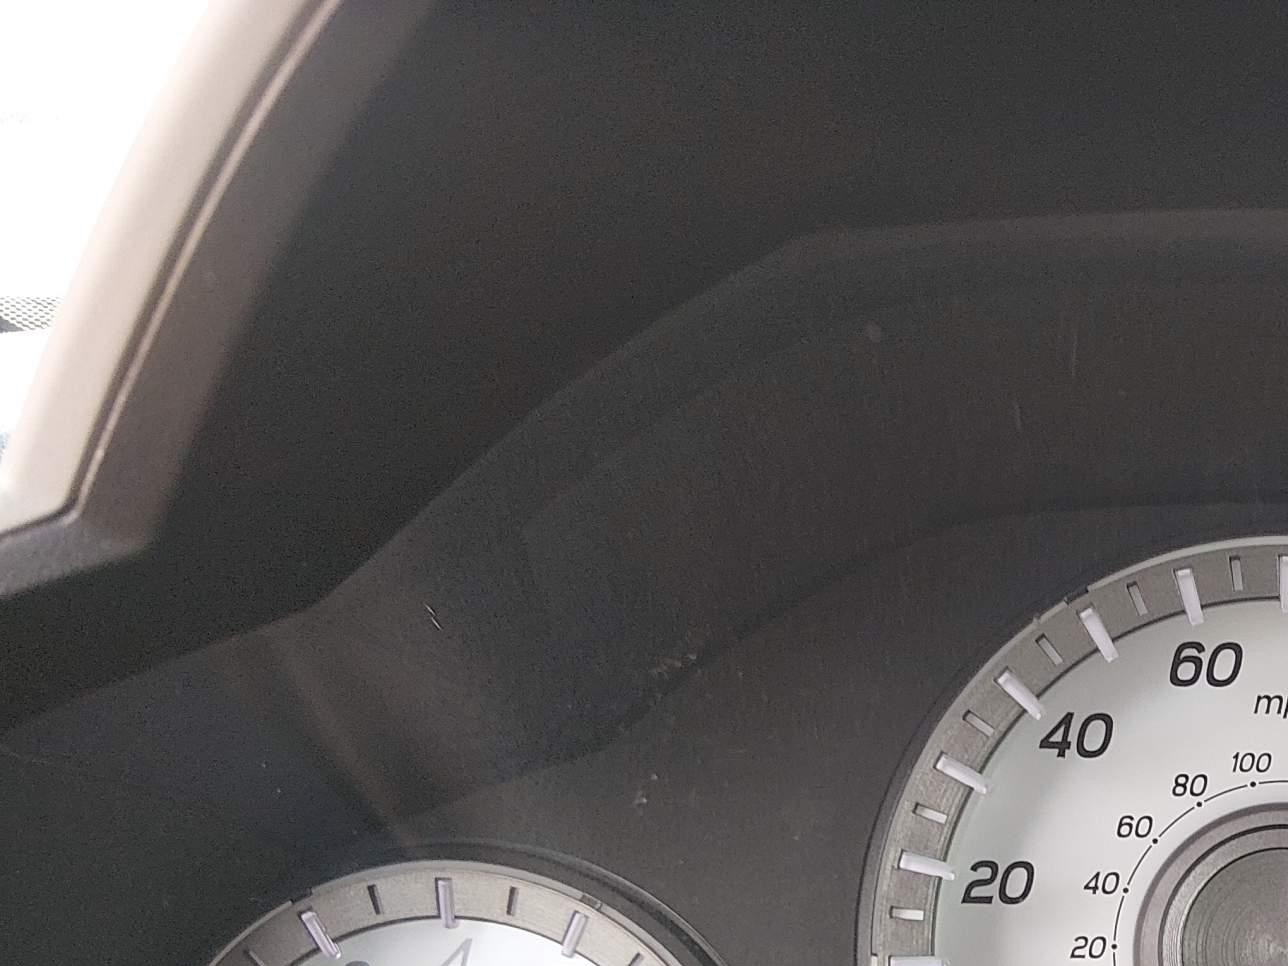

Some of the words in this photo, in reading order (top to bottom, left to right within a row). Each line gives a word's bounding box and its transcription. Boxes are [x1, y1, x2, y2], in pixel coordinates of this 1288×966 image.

[1170, 641, 1242, 687] 60
[1039, 712, 1113, 758] 40
[1232, 751, 1272, 772] 100
[1172, 773, 1207, 797] 80
[1117, 815, 1152, 839] 60
[961, 861, 1034, 905] 20
[1084, 871, 1119, 895] 40
[1070, 935, 1106, 959] 20
